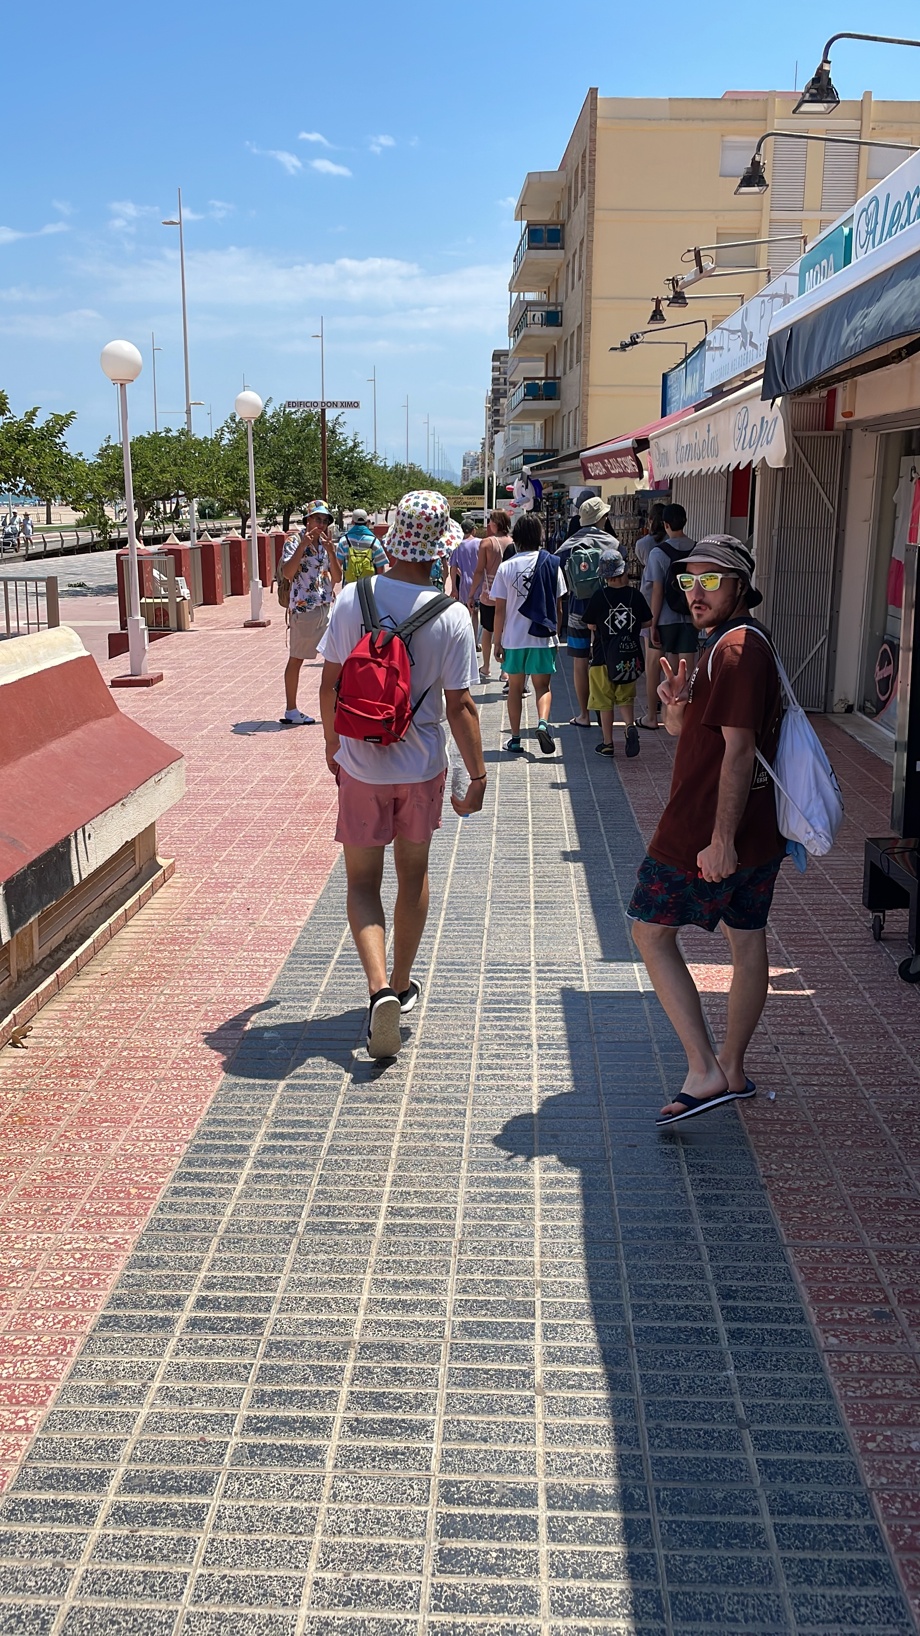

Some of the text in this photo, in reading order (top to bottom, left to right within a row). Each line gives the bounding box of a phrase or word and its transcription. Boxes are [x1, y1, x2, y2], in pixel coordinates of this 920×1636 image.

[805, 253, 835, 291] MODA
[675, 423, 719, 465] Camisetas
[733, 406, 778, 456] Ropa
